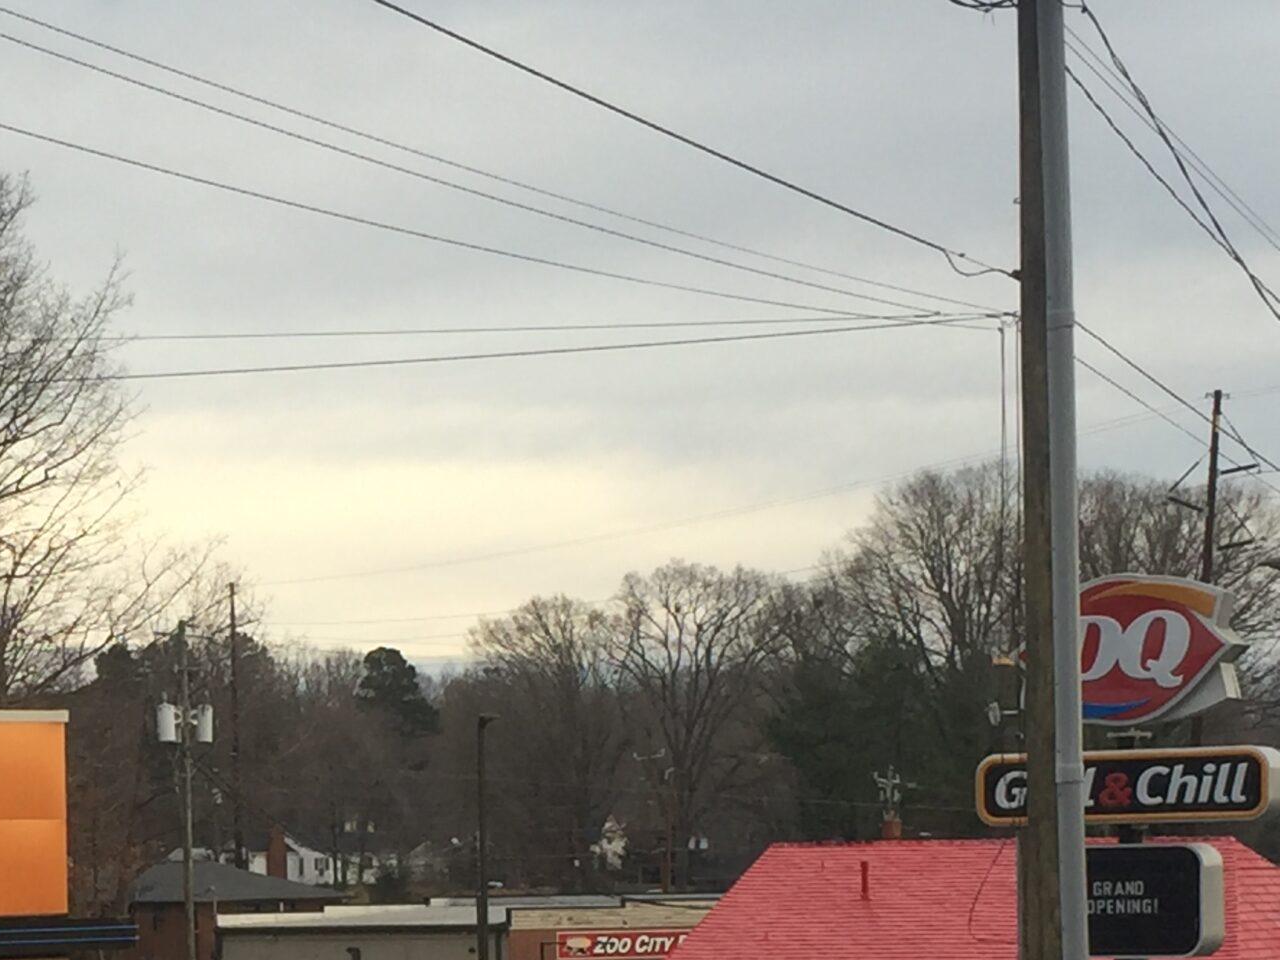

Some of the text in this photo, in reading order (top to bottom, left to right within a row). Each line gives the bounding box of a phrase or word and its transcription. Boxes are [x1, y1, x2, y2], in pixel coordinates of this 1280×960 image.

[1136, 762, 1248, 806] Chill
[1093, 881, 1144, 896] GRAND
[1087, 898, 1158, 914] OPENING!
[593, 936, 632, 954] ZOO
[635, 935, 674, 953] CITY
